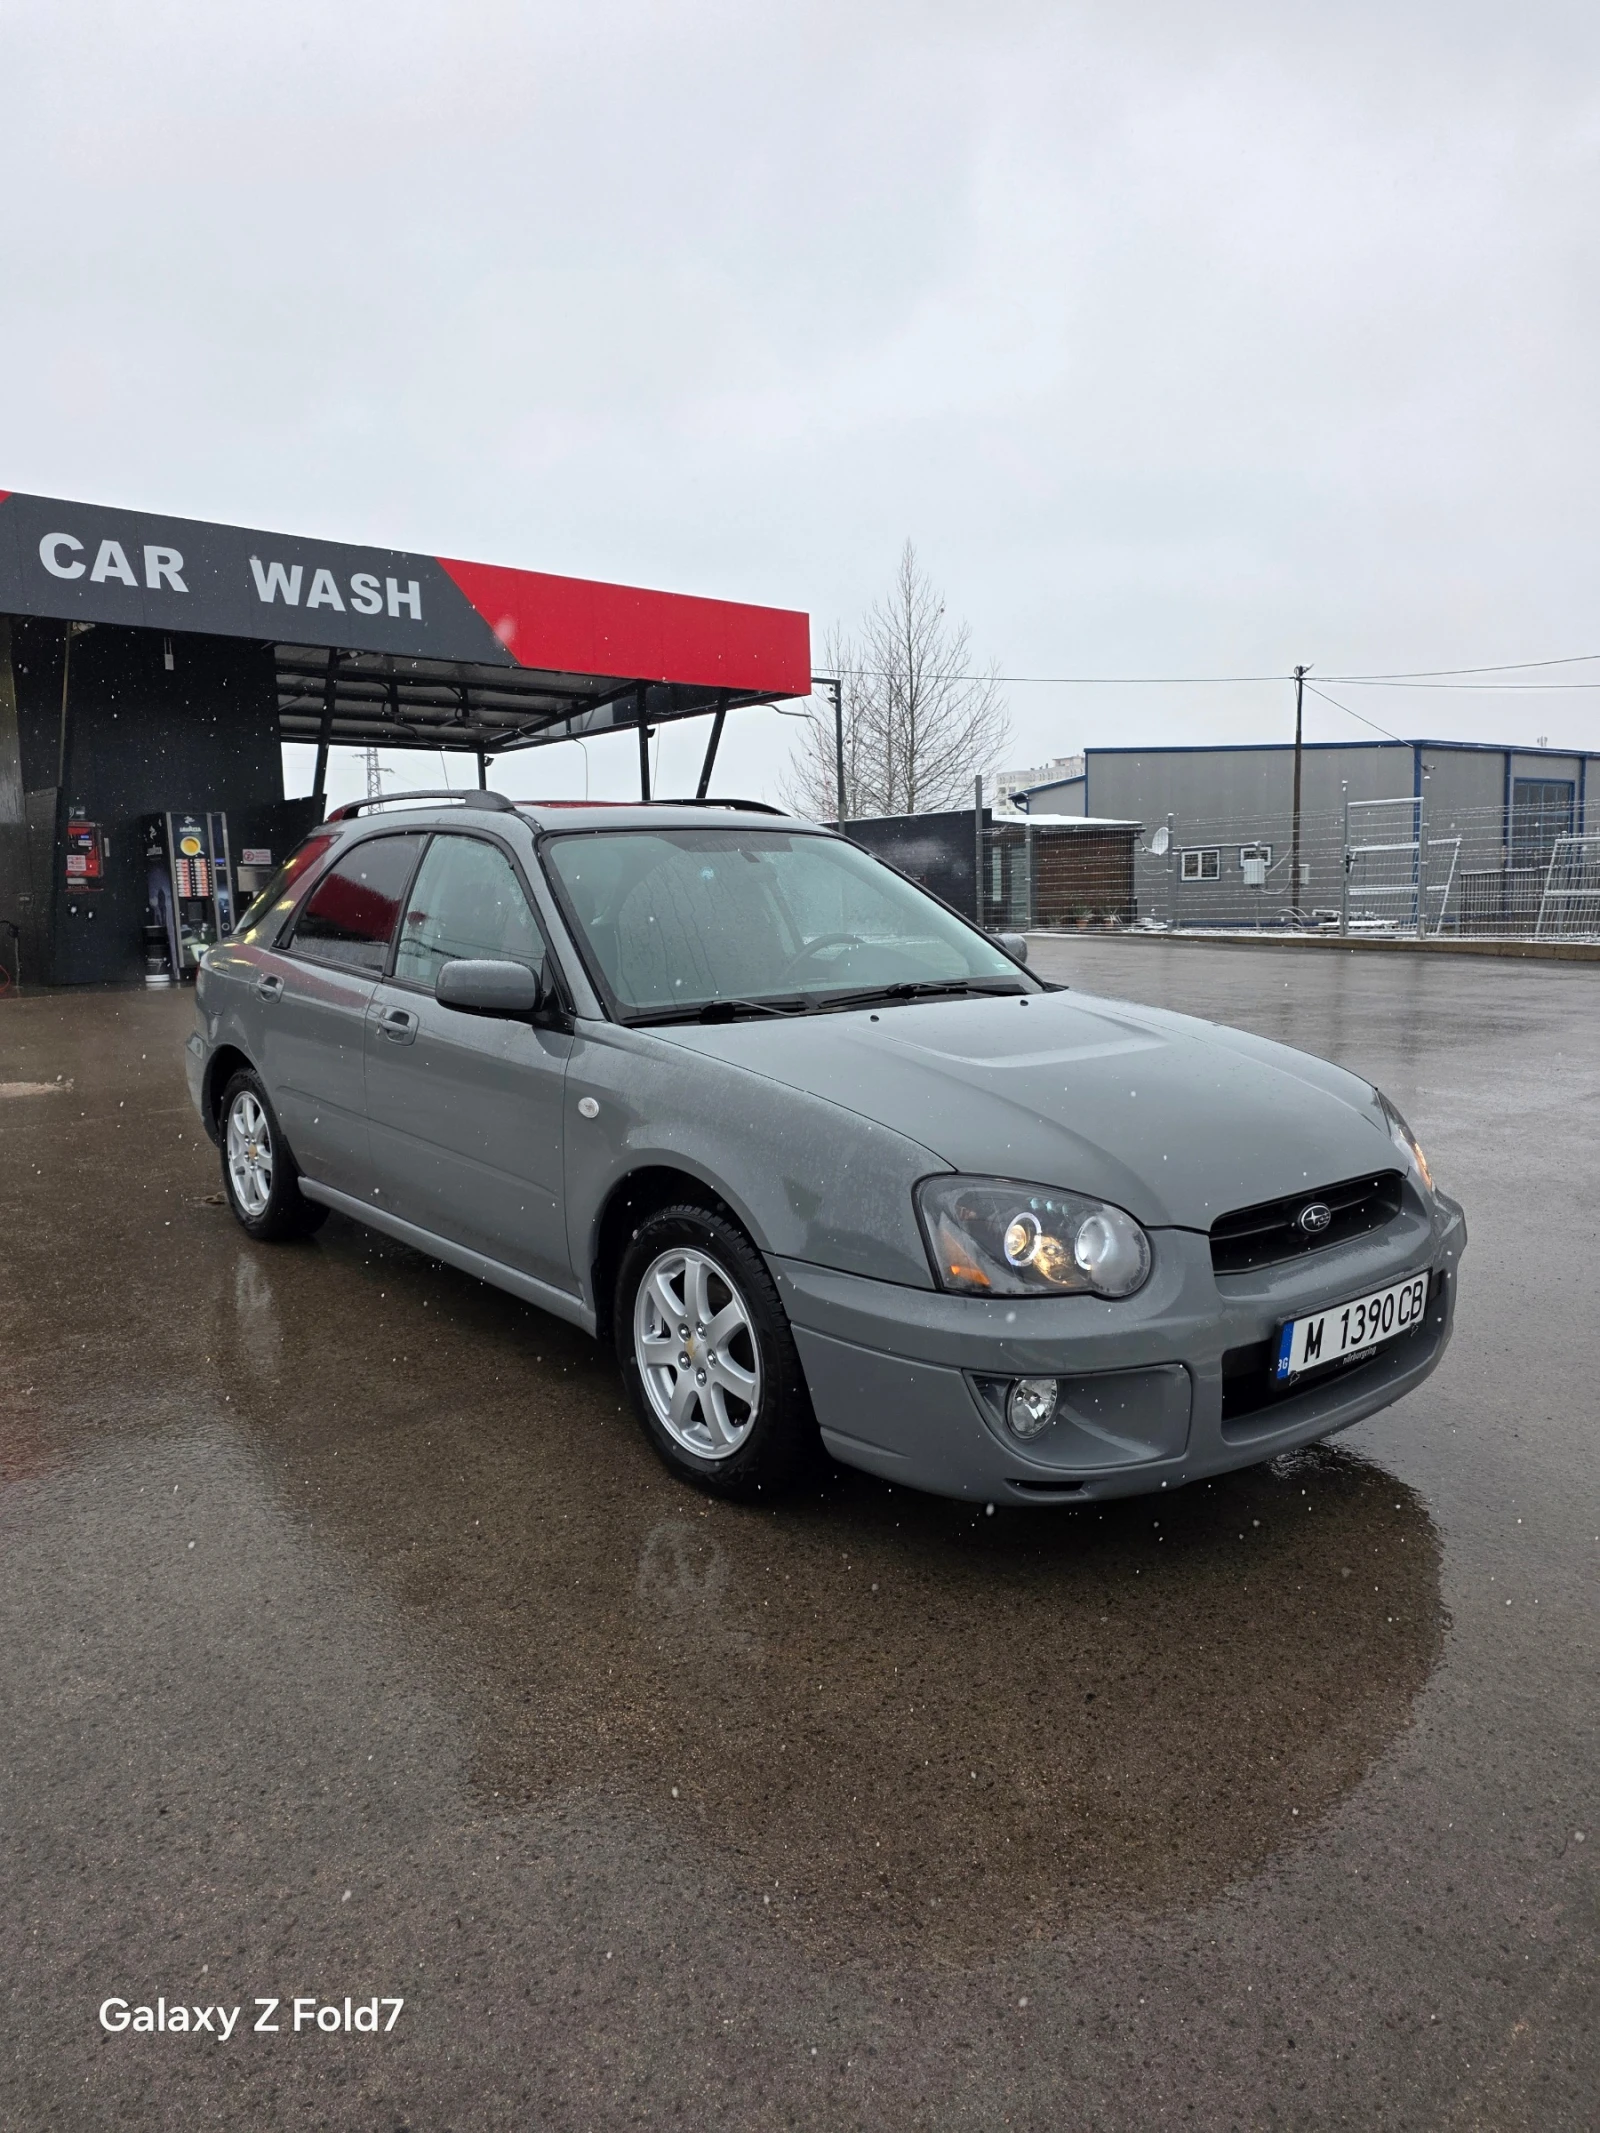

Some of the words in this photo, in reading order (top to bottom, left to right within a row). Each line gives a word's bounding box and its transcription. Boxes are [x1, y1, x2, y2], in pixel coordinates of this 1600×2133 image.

[39, 532, 189, 593] CAR
[249, 558, 422, 620] WASH
[1303, 1317, 1325, 1364] M
[1340, 1293, 1395, 1350] 1390
[1398, 1280, 1424, 1326] CB
